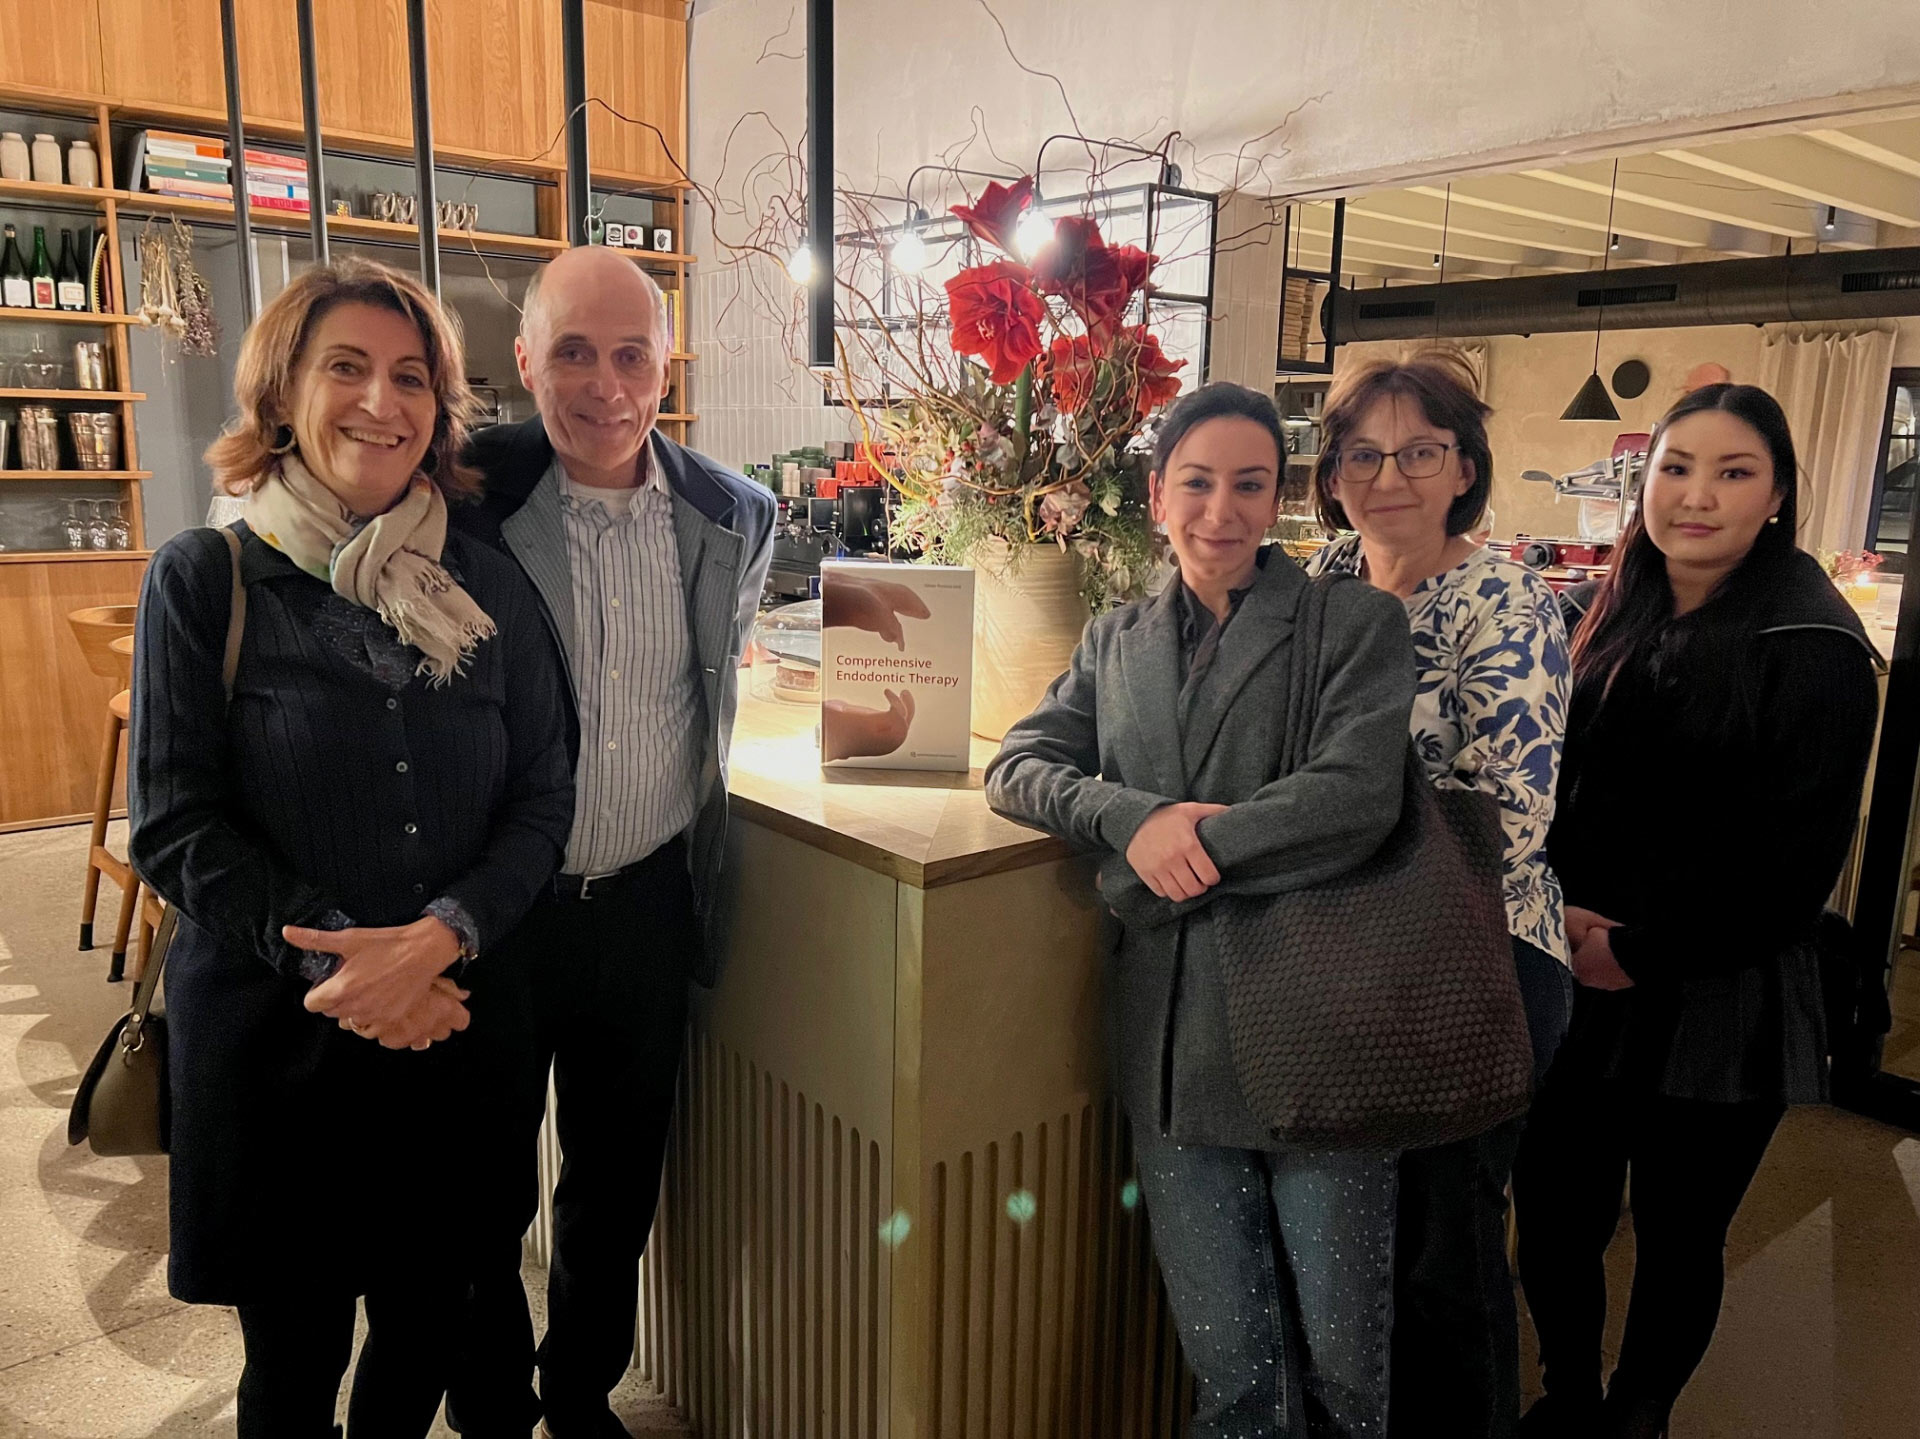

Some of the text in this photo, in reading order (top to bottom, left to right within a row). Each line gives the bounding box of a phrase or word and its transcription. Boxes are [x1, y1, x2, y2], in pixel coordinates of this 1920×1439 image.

[836, 655, 932, 669] Comprehensive
[836, 670, 959, 687] Endodontic Therapy
